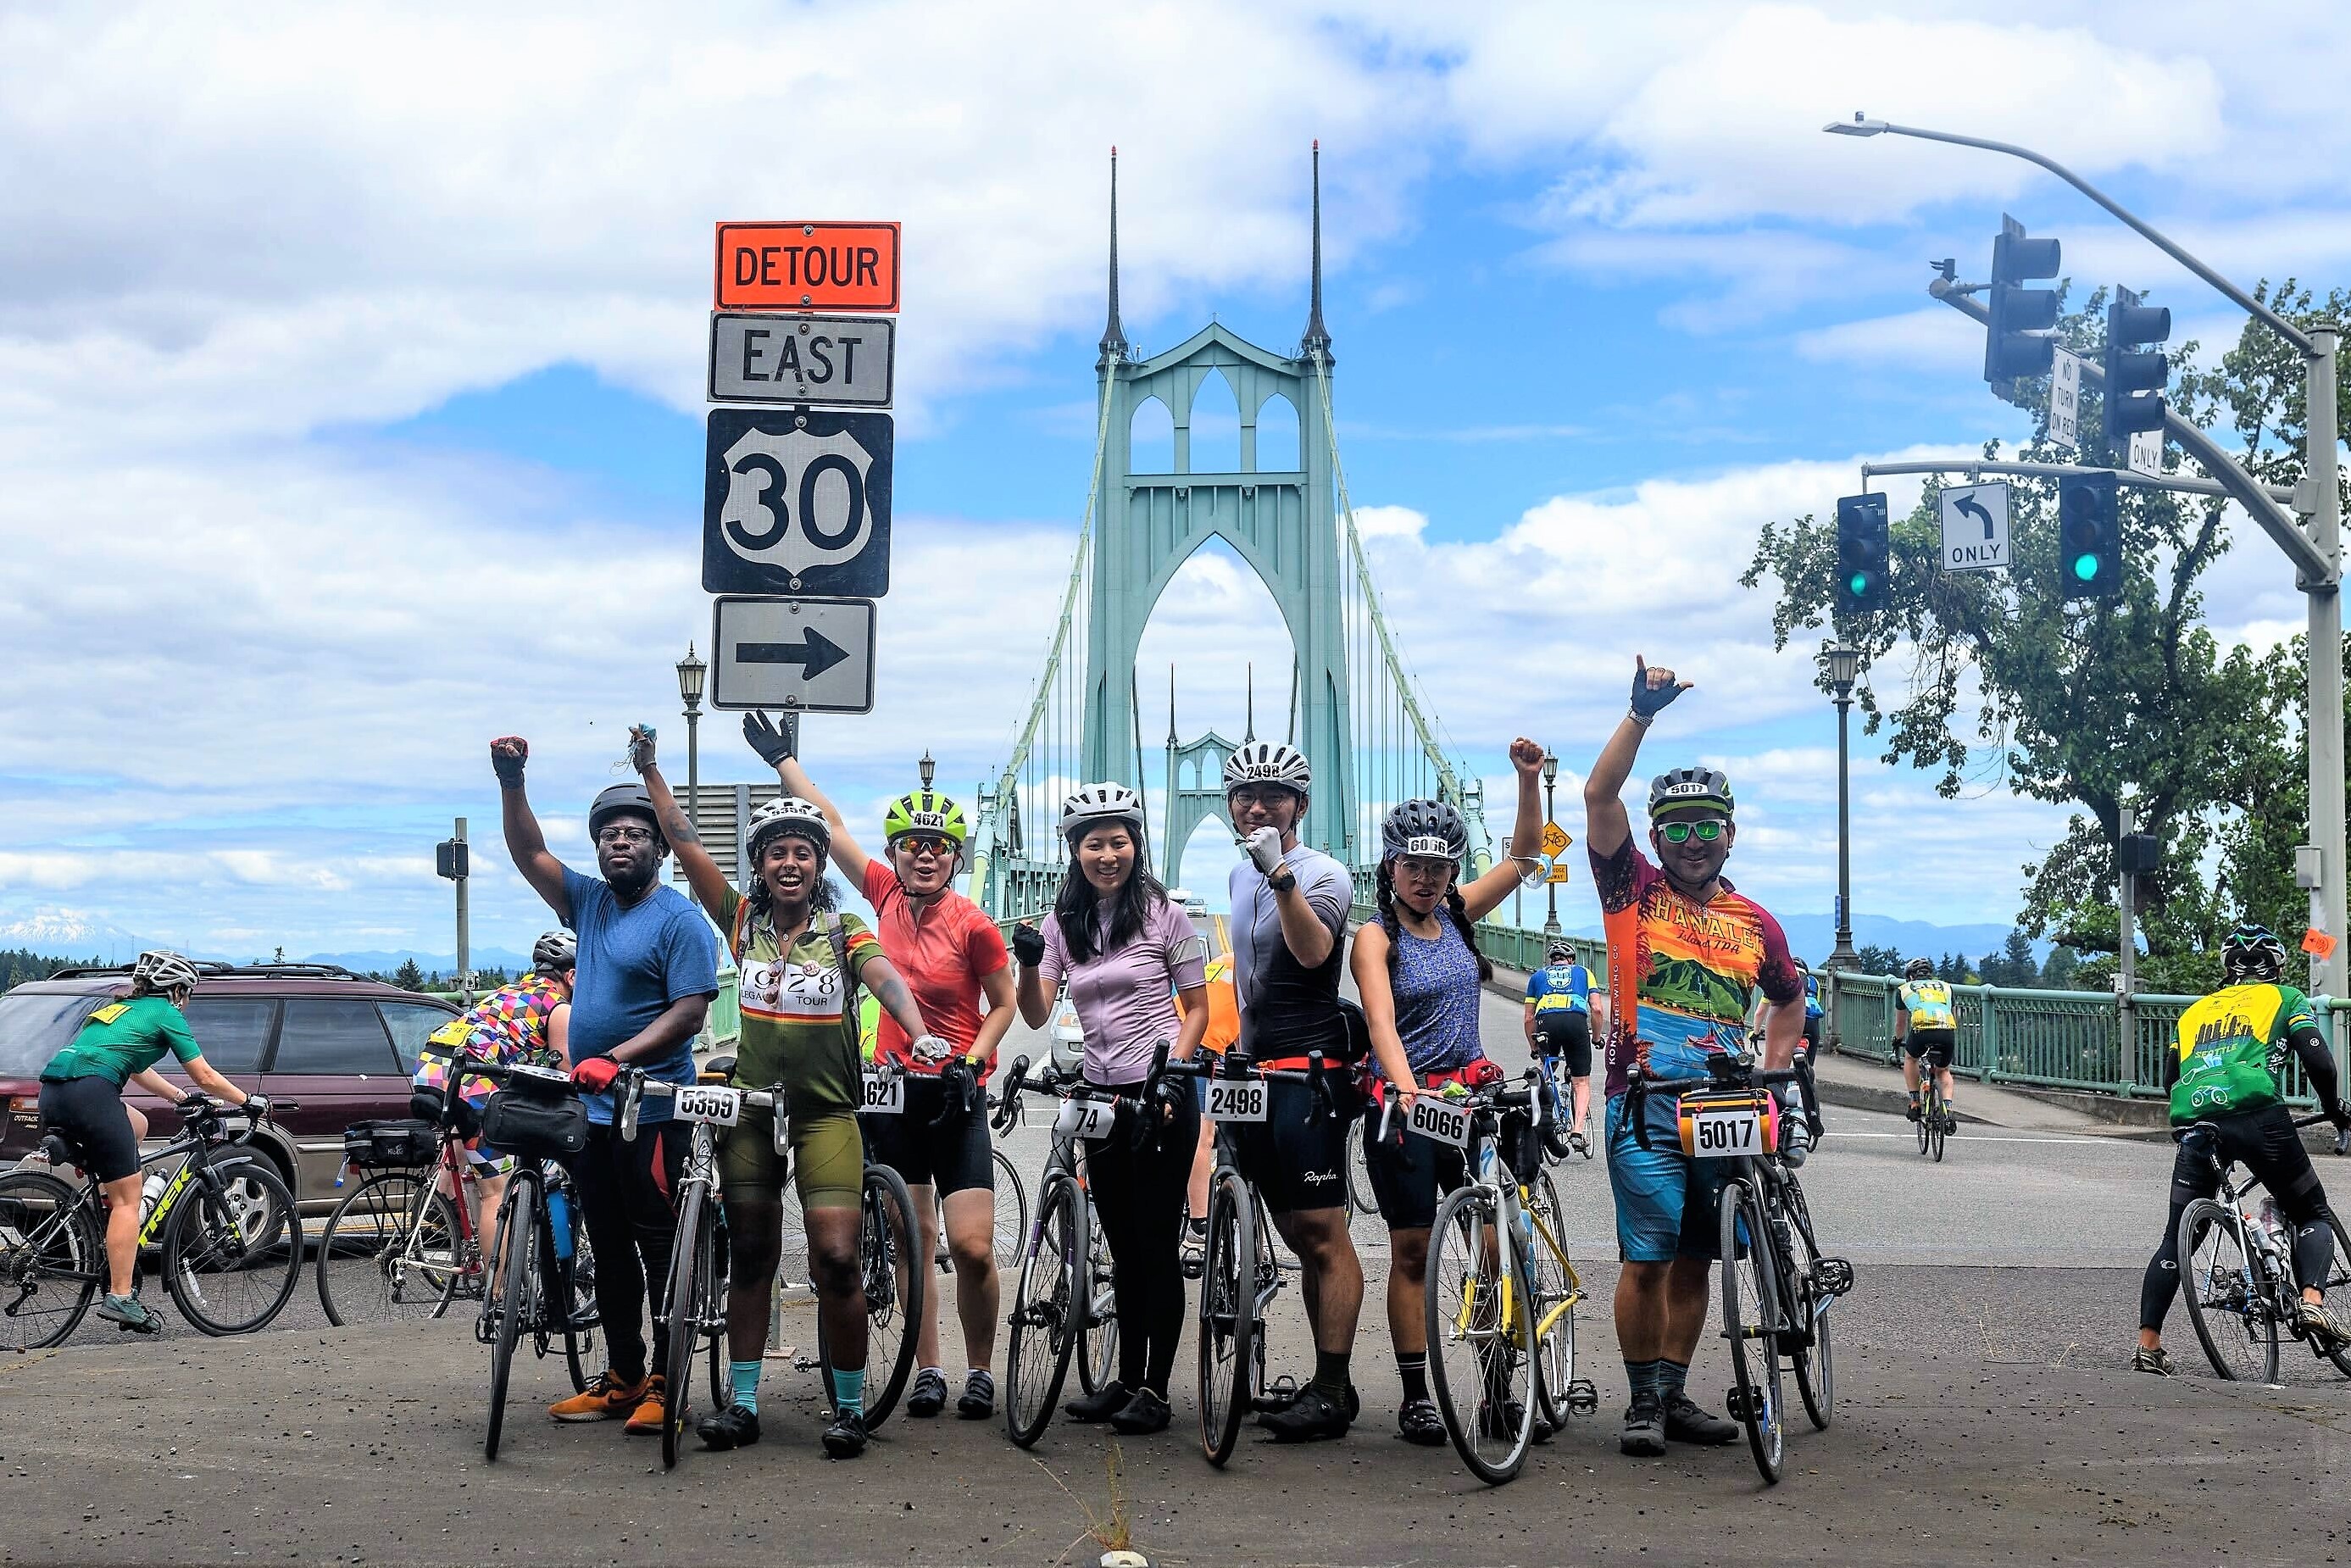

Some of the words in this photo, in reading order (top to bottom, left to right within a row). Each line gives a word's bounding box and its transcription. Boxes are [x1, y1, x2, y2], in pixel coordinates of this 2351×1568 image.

[735, 246, 879, 286] DETOUR
[742, 329, 862, 384] EAST
[2062, 360, 2071, 381] NO
[2057, 386, 2074, 410] TURN
[2052, 412, 2061, 431] ON
[2062, 417, 2075, 437] RED
[2134, 444, 2159, 469] ONLY
[725, 453, 864, 551] 30
[1952, 543, 2000, 563] ONLY
[1247, 765, 1281, 780] 2498
[1670, 784, 1704, 794] 5017
[914, 813, 944, 828] 4621
[1410, 838, 1446, 854] 6066
[1655, 897, 1760, 953] HANALEI
[1676, 929, 1709, 948] Island
[742, 967, 835, 995] 1928
[741, 988, 763, 1001] LEGA
[796, 995, 828, 1007] TOUR
[1609, 1031, 1619, 1065] KONA
[681, 1090, 734, 1119] 5359
[1210, 1087, 1262, 1115] 2498
[1074, 1107, 1098, 1132] 74
[1413, 1103, 1465, 1140] 6066
[1698, 1120, 1754, 1149] 5017
[1303, 1169, 1337, 1186] Rapha
[138, 1164, 193, 1248] TREK
